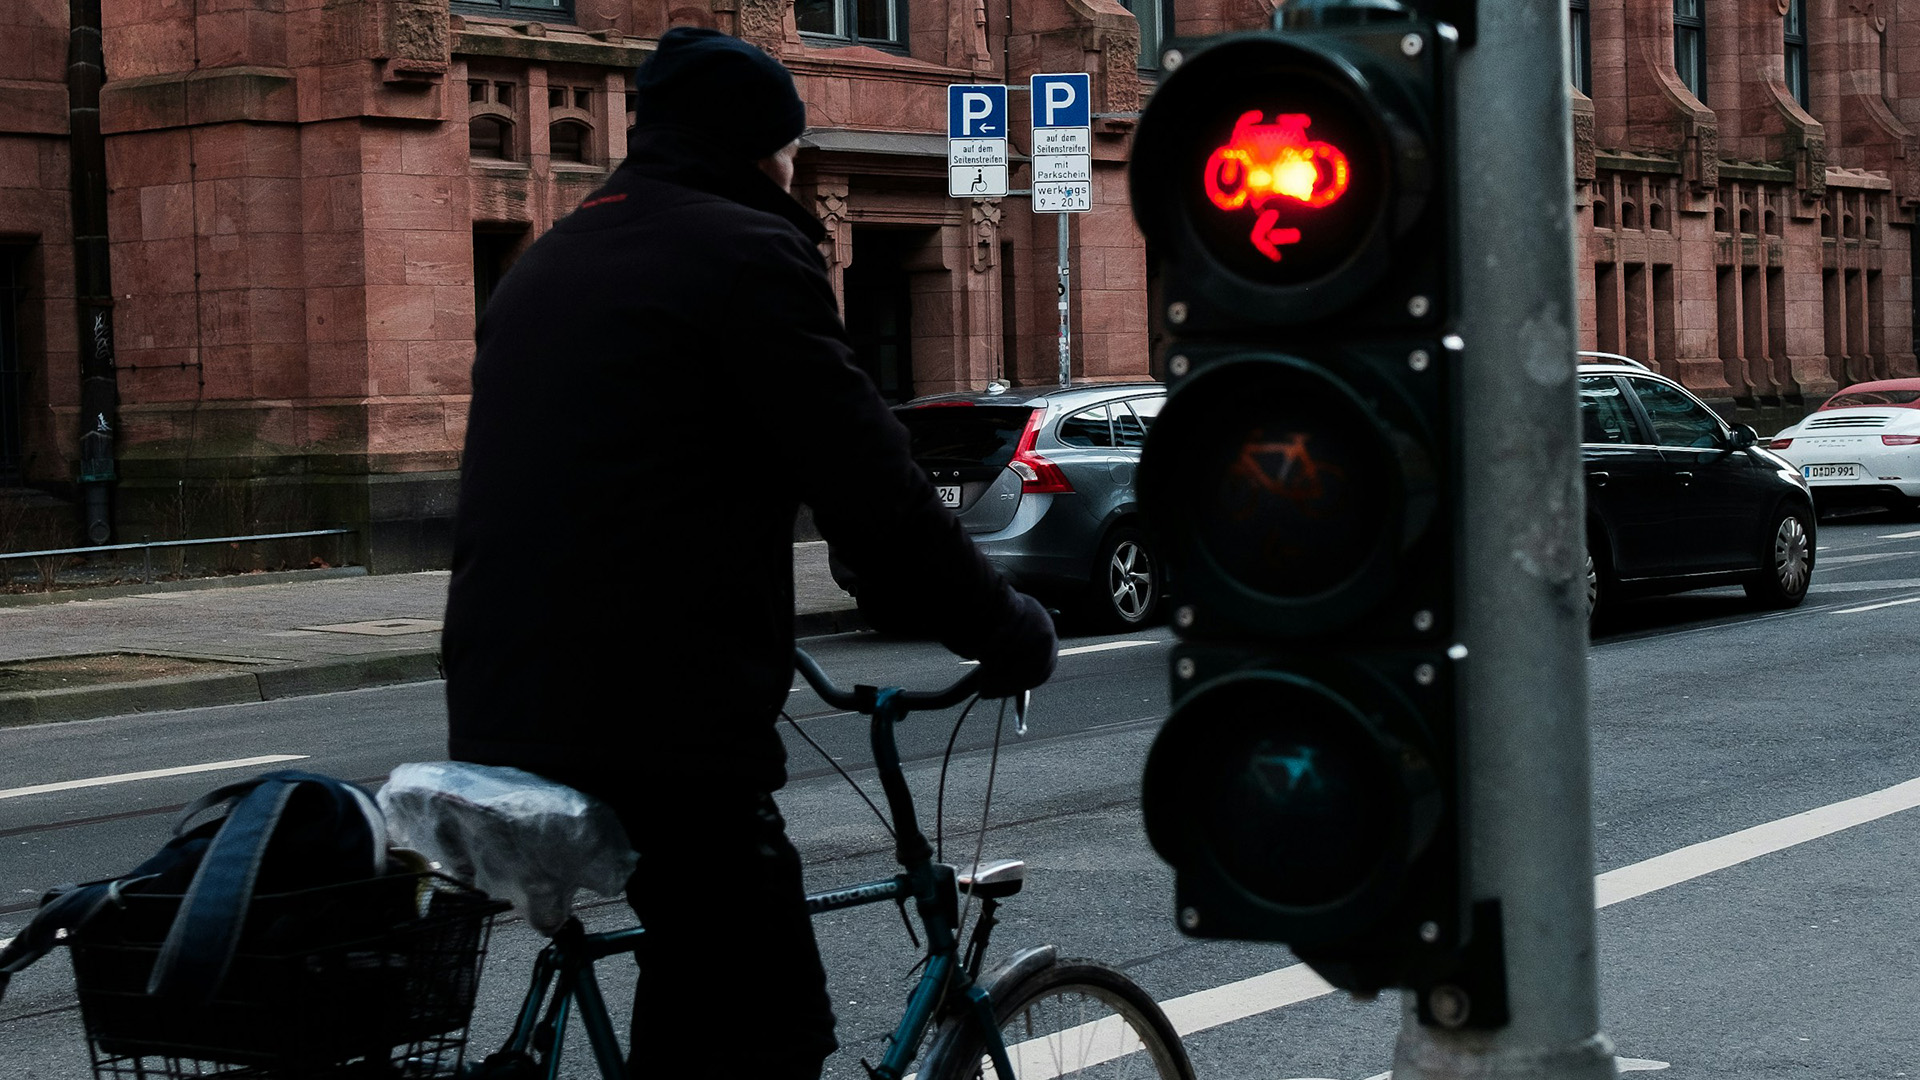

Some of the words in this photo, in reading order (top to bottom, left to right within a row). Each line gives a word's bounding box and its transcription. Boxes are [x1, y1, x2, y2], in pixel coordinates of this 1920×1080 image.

[1045, 82, 1076, 125] P
[962, 92, 993, 136] P
[1046, 134, 1058, 142] auf
[1061, 134, 1076, 142] dem
[963, 145, 974, 153] auf
[978, 145, 993, 153] dem
[1037, 144, 1086, 153] Seitenstreifen
[953, 154, 1003, 164] Seitenstreifen
[1054, 161, 1068, 169] mit
[1037, 171, 1086, 179] Parkschein
[1040, 198, 1046, 207] 9
[1061, 198, 1074, 207] 20
[1078, 198, 1084, 207] h
